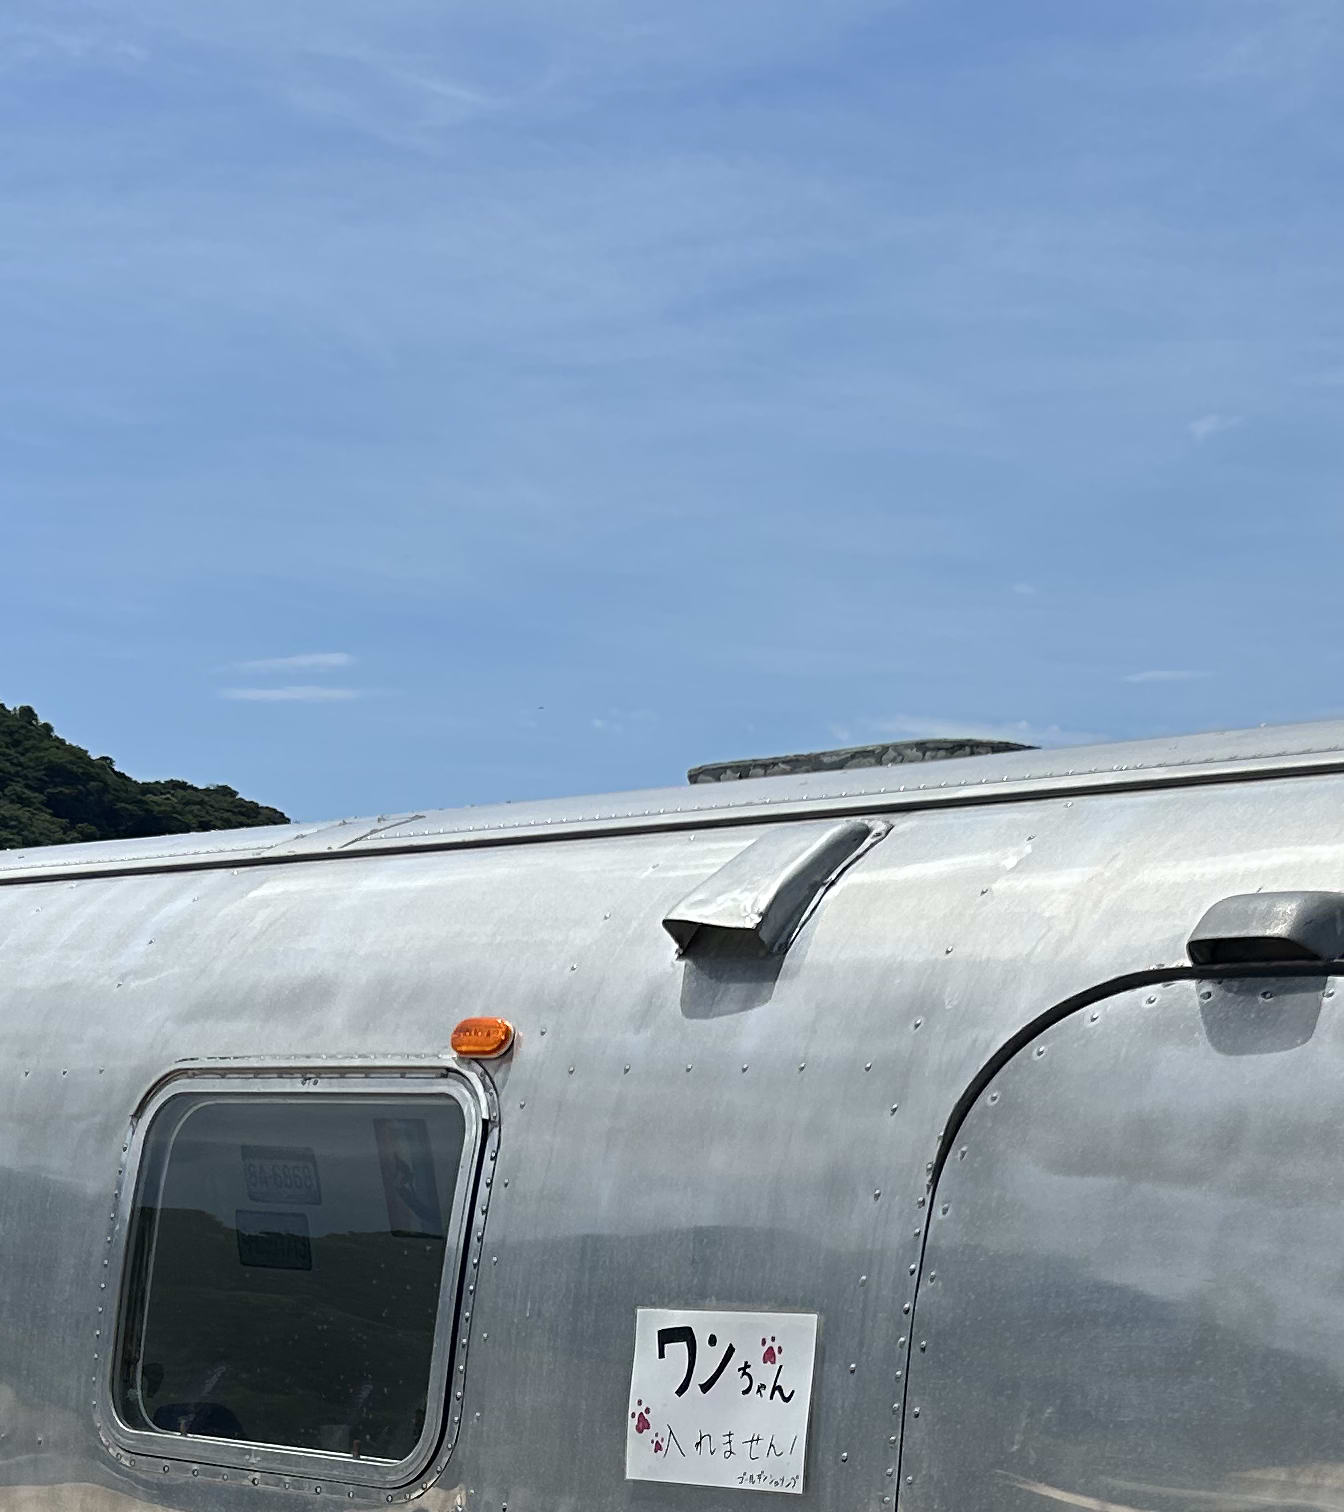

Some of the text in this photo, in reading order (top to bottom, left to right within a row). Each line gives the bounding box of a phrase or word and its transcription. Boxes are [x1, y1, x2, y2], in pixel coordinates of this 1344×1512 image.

[657, 1326, 796, 1403] ワンちゃん
